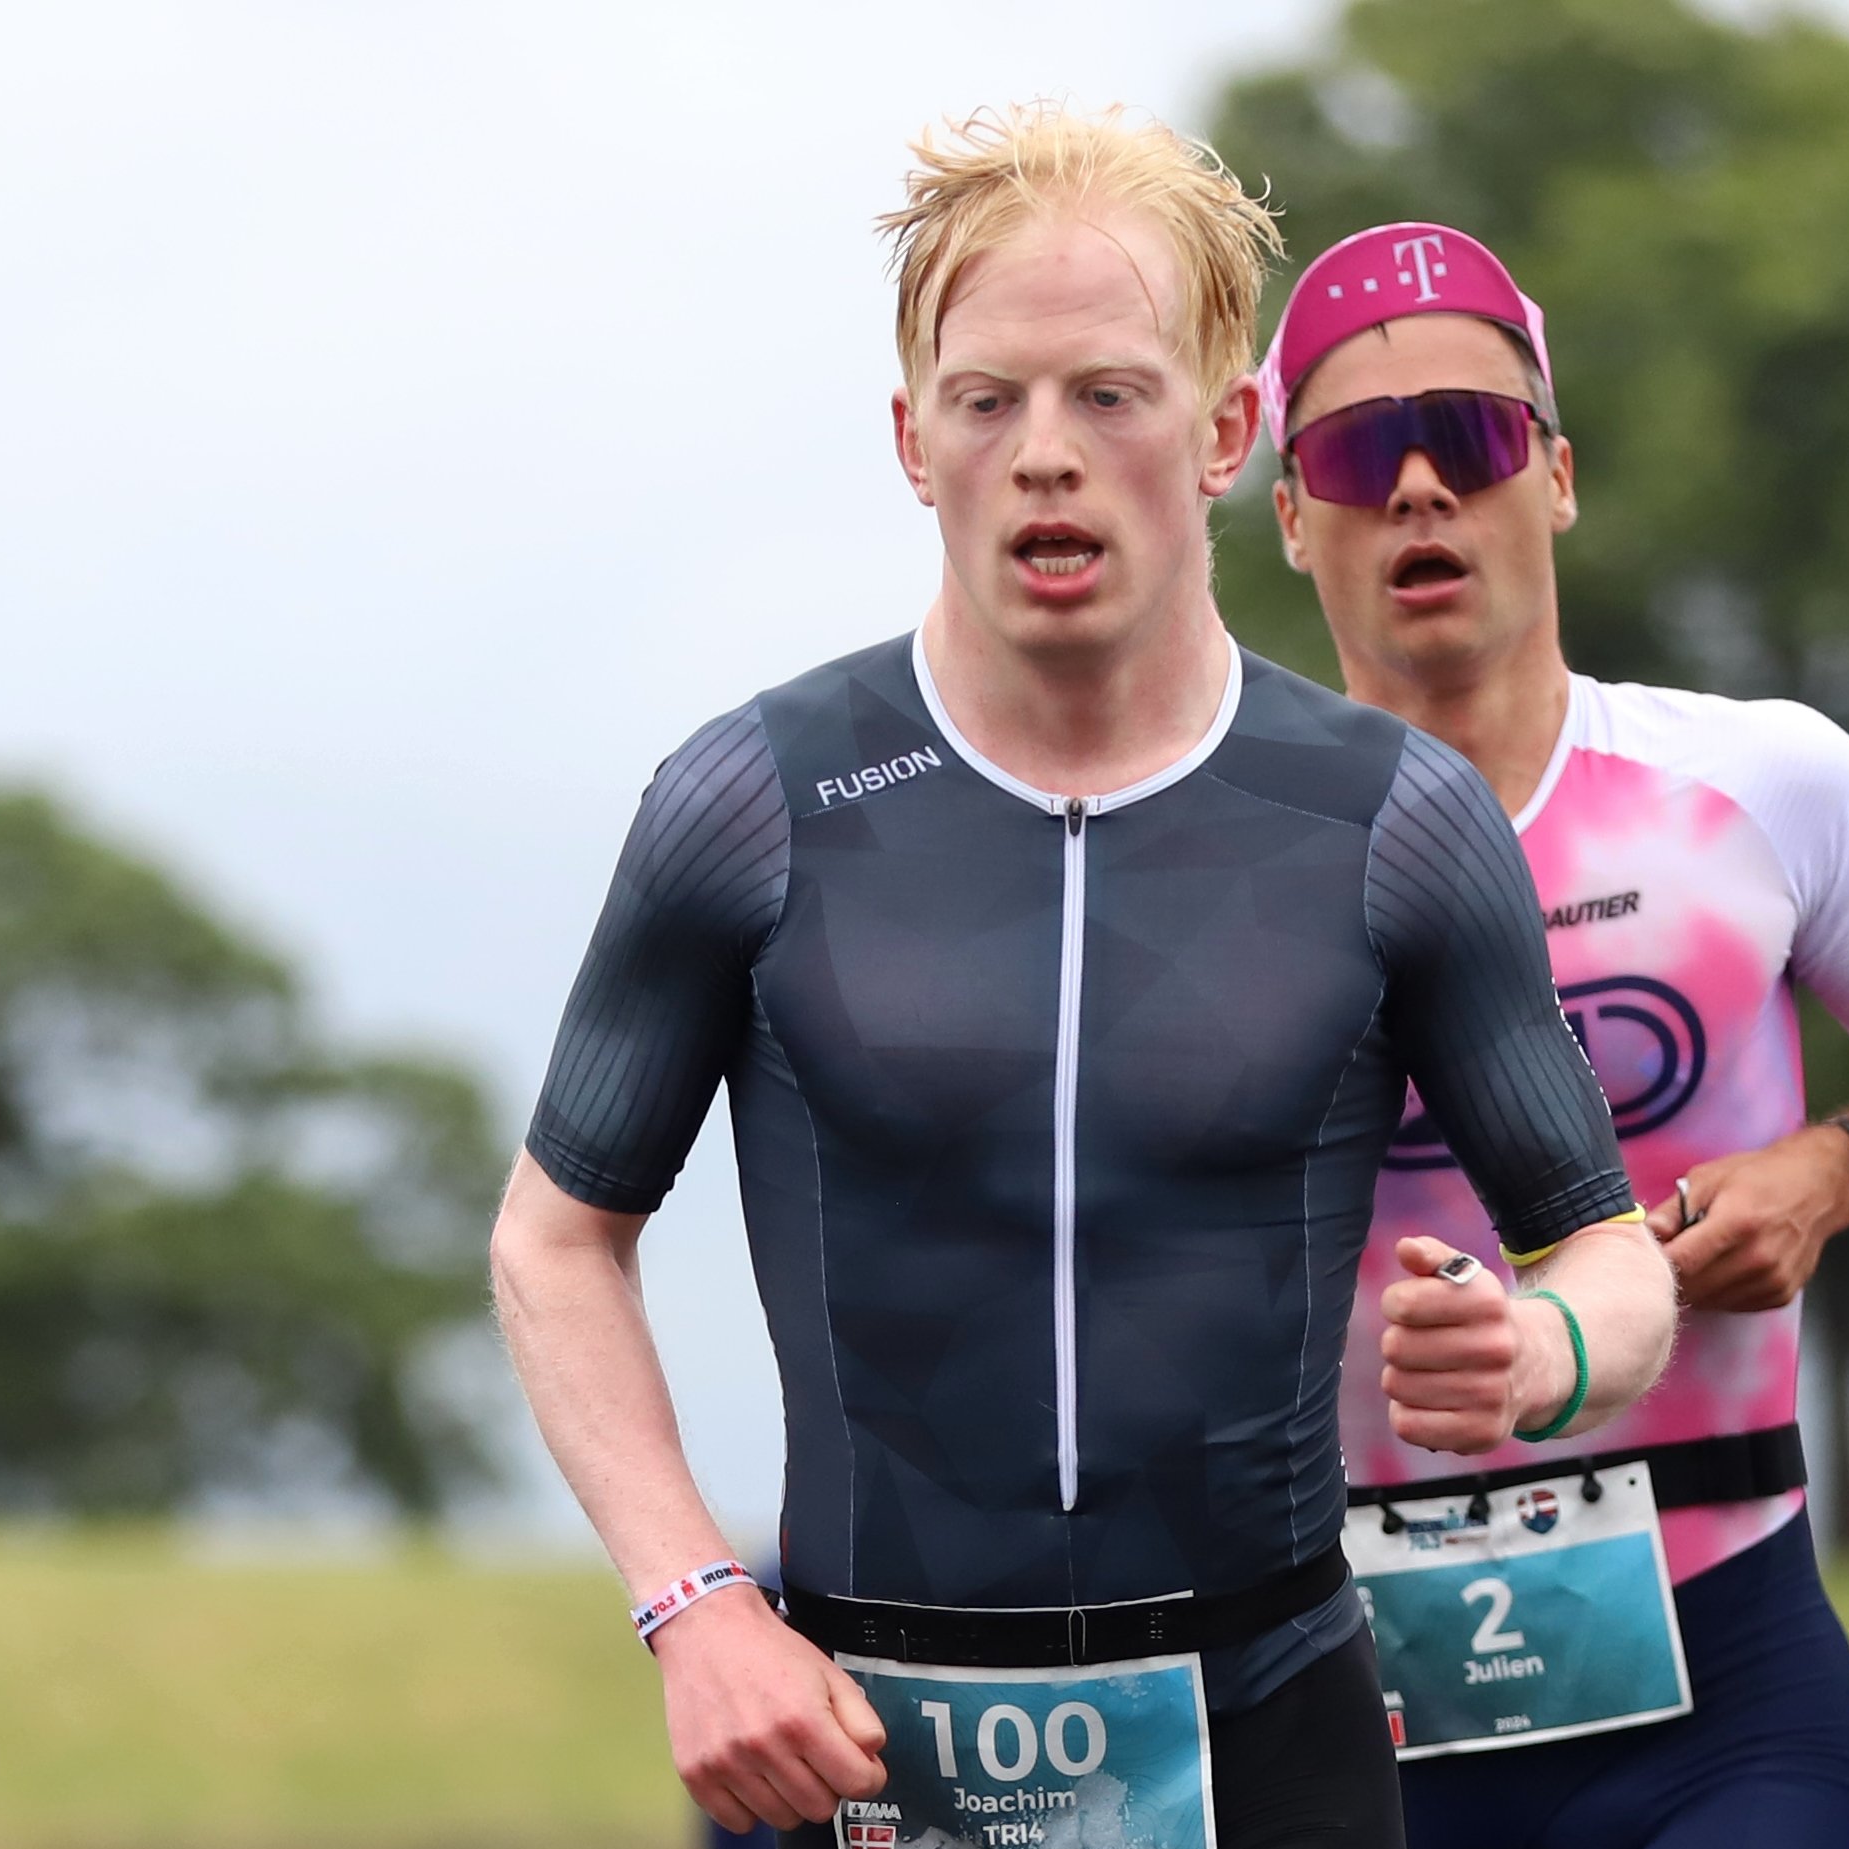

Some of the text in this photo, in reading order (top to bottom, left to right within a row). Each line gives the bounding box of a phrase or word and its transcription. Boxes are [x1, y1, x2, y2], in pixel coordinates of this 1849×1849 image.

[815, 745, 943, 806] FUSION
[1542, 890, 1639, 931] AUTIER
[1460, 1577, 1526, 1655] 2
[1463, 1654, 1545, 1685] Julien
[920, 1700, 1108, 1783] 100
[954, 1786, 1077, 1815] Joachim
[982, 1823, 1046, 1848] TRI4
